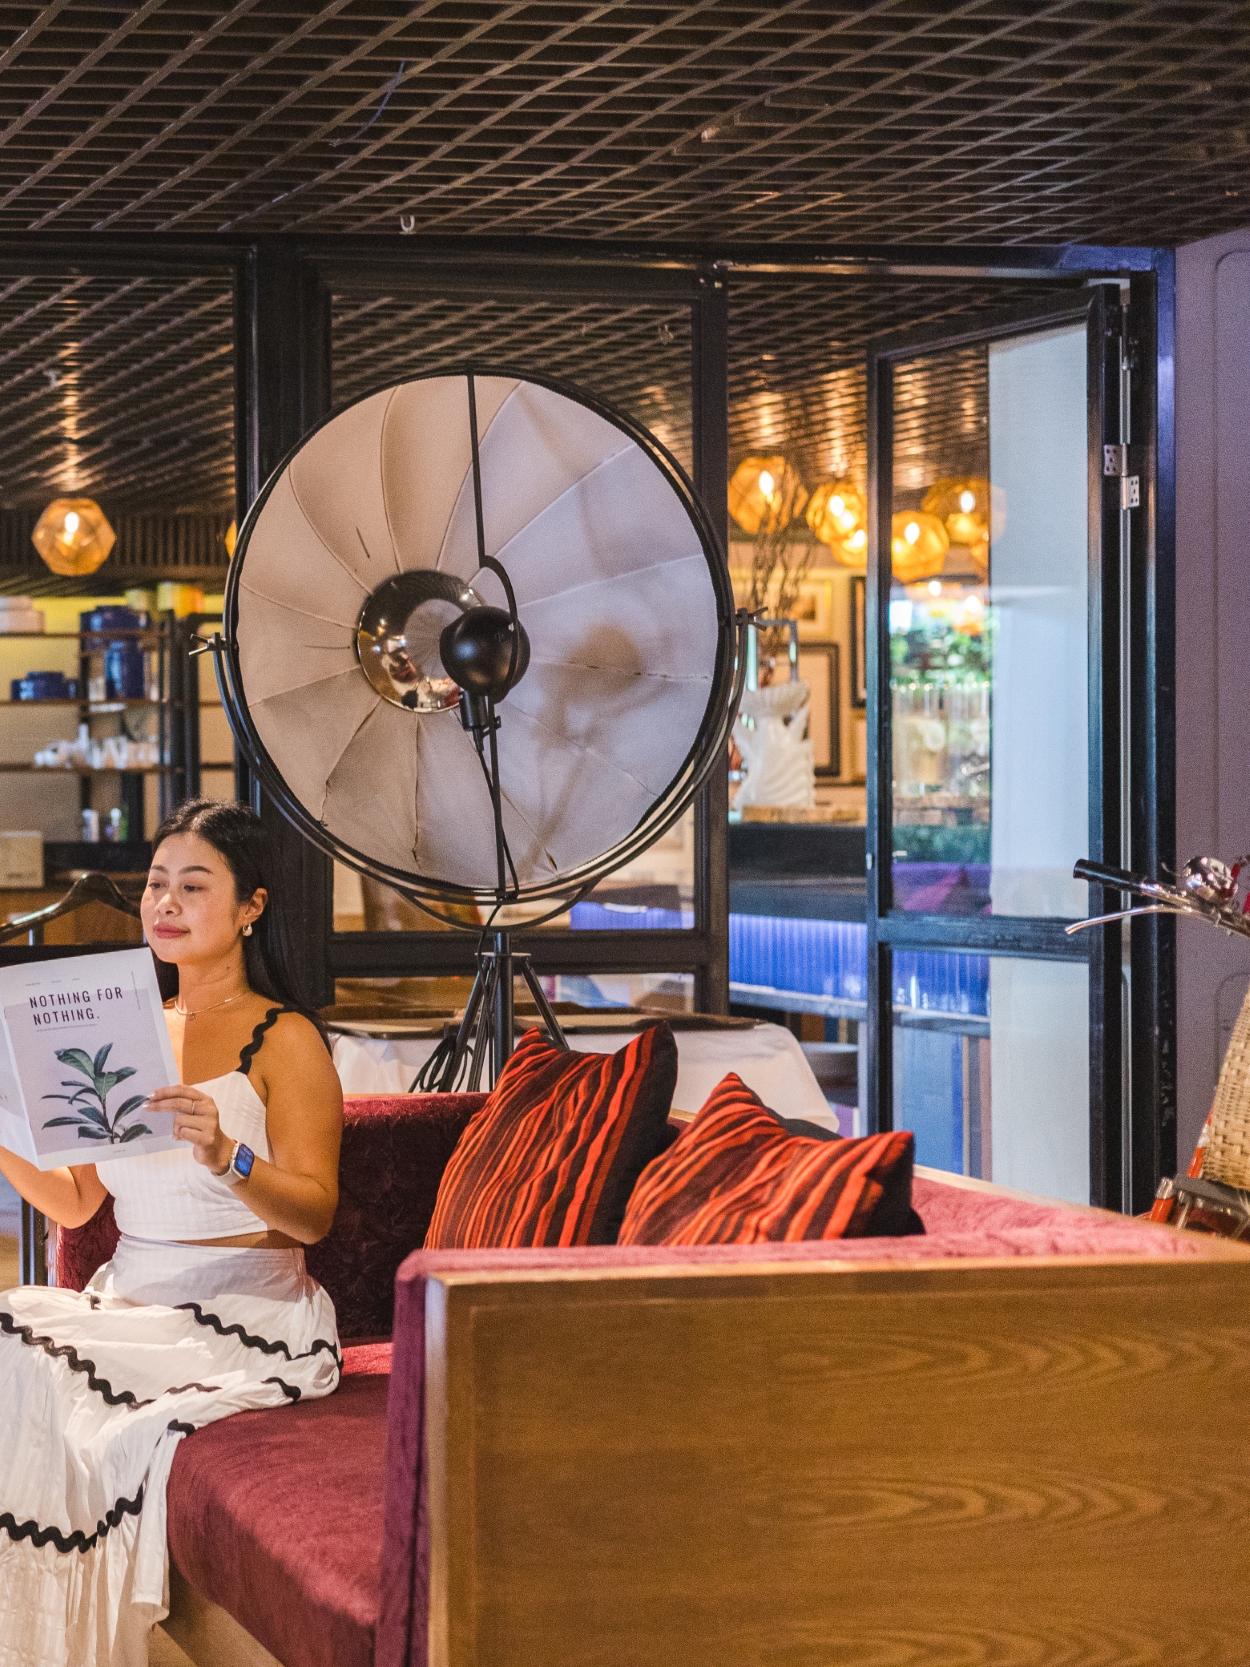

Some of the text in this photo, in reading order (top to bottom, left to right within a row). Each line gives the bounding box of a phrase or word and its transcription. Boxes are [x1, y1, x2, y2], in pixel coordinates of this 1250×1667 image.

[29, 990, 91, 1009] NOTHING
[96, 986, 123, 1001] FOR
[33, 1007, 100, 1026] NOTHING.
